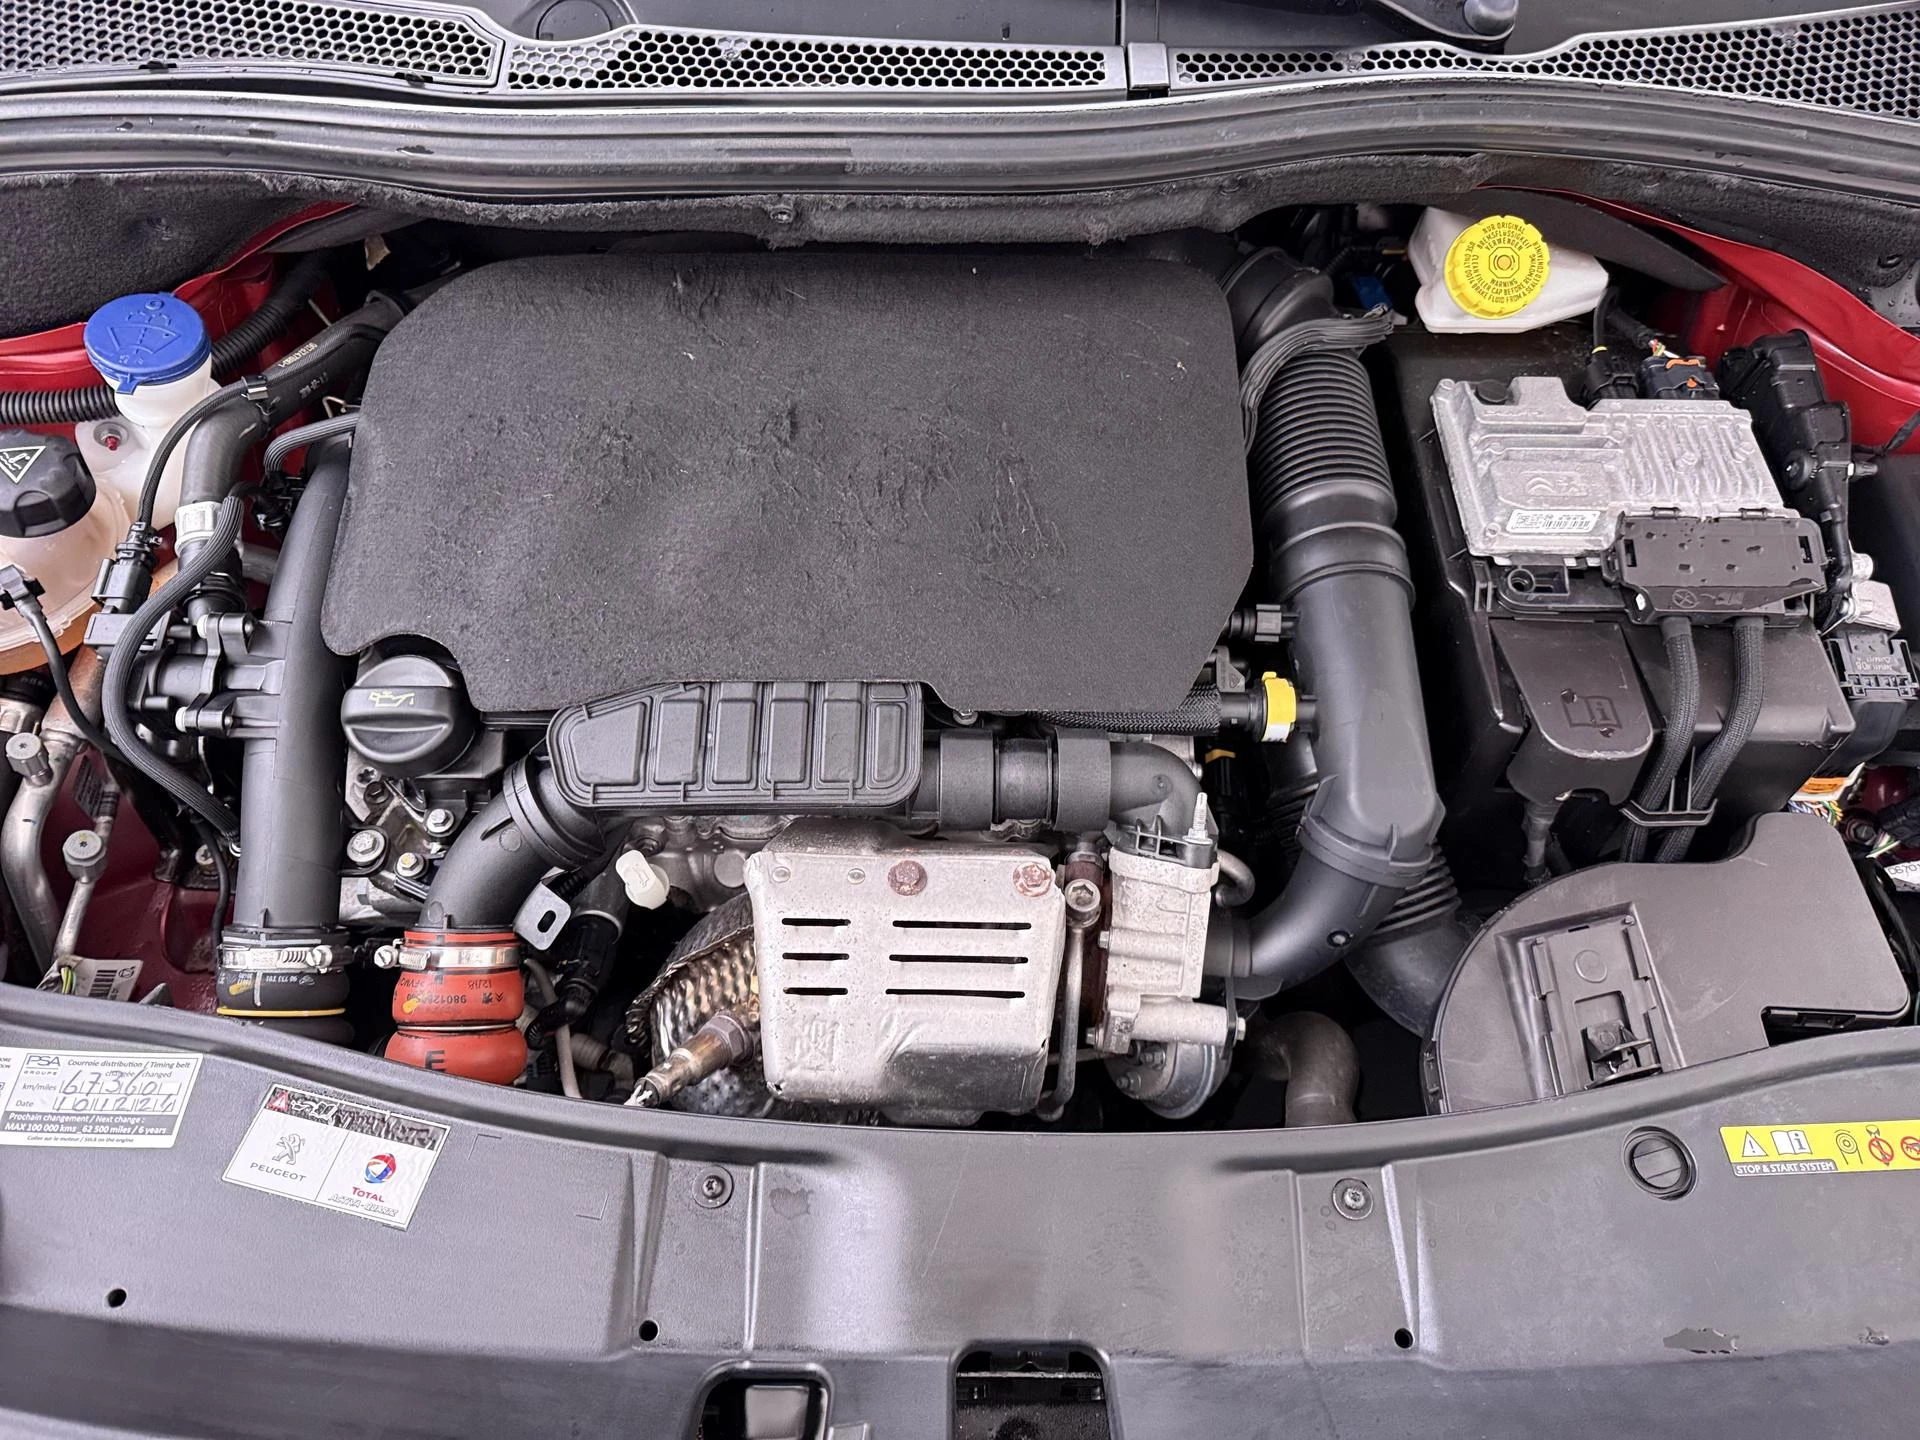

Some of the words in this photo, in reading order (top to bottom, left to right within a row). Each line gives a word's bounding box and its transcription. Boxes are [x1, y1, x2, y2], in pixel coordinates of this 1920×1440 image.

[1497, 222, 1526, 235] ORIGINAL
[1466, 241, 1475, 253] USE
[1490, 278, 1518, 288] WARNING
[1491, 287, 1503, 296] CAP
[26, 1055, 60, 1067] PSA
[67, 1059, 99, 1067] Courroie
[100, 1060, 143, 1068] distribution
[150, 1061, 174, 1069] Timing
[142, 1070, 173, 1079] changed
[22, 1083, 57, 1091] km/miles
[15, 1100, 34, 1108] Date
[8, 1112, 42, 1121] Prochain
[43, 1115, 89, 1124] changement
[95, 1116, 114, 1124] Next
[4, 1122, 27, 1131] MAX
[27, 1123, 43, 1132] 100
[43, 1123, 60, 1132] 000
[60, 1124, 77, 1133] kms
[82, 1125, 94, 1133] 62
[94, 1125, 110, 1134] 500
[109, 1125, 133, 1134] miles
[145, 1127, 167, 1136] years
[249, 1161, 307, 1182] PEUGEOT
[1736, 1165, 1761, 1174] STOP
[1762, 1164, 1770, 1173] &
[1770, 1163, 1799, 1173] START
[1800, 1161, 1835, 1172] SYSTEM
[352, 1186, 385, 1203] TOTAL
